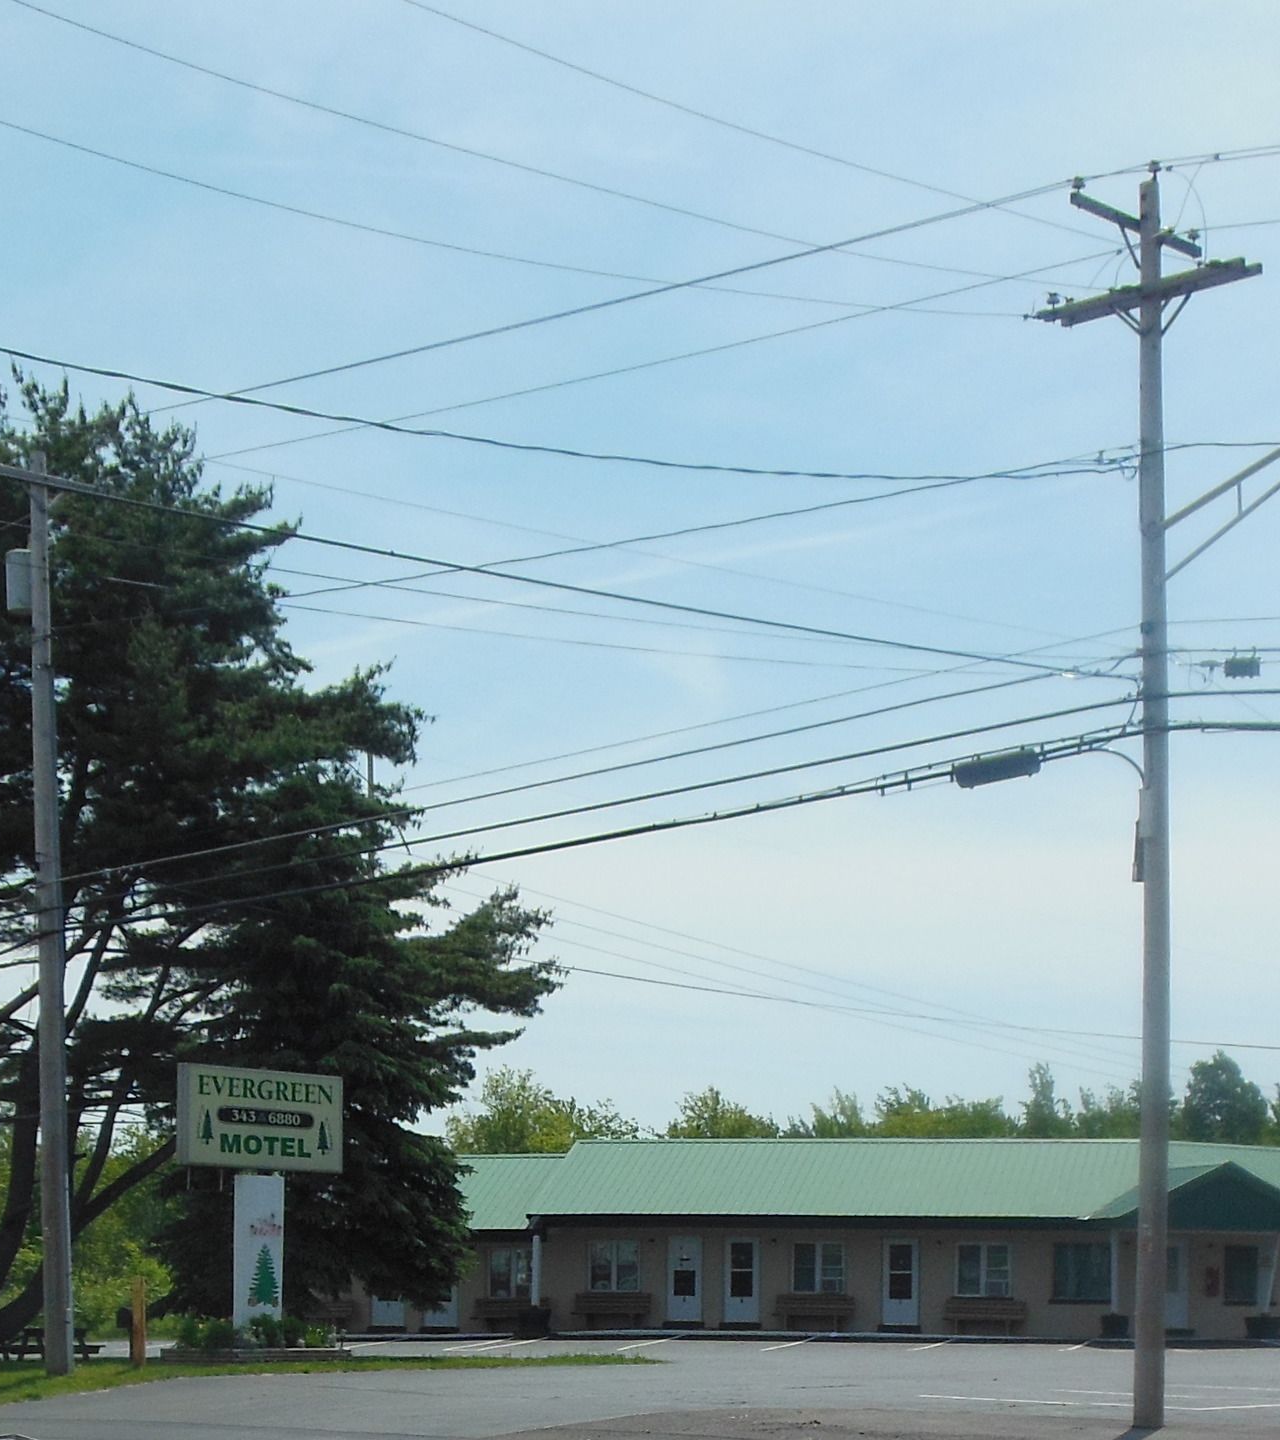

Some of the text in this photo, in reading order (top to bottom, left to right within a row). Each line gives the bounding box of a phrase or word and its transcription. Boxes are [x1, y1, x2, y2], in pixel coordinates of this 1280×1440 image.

[198, 1074, 334, 1105] EVERGREEN
[231, 1109, 301, 1126] 343 6880
[220, 1133, 312, 1158] MOTEL
